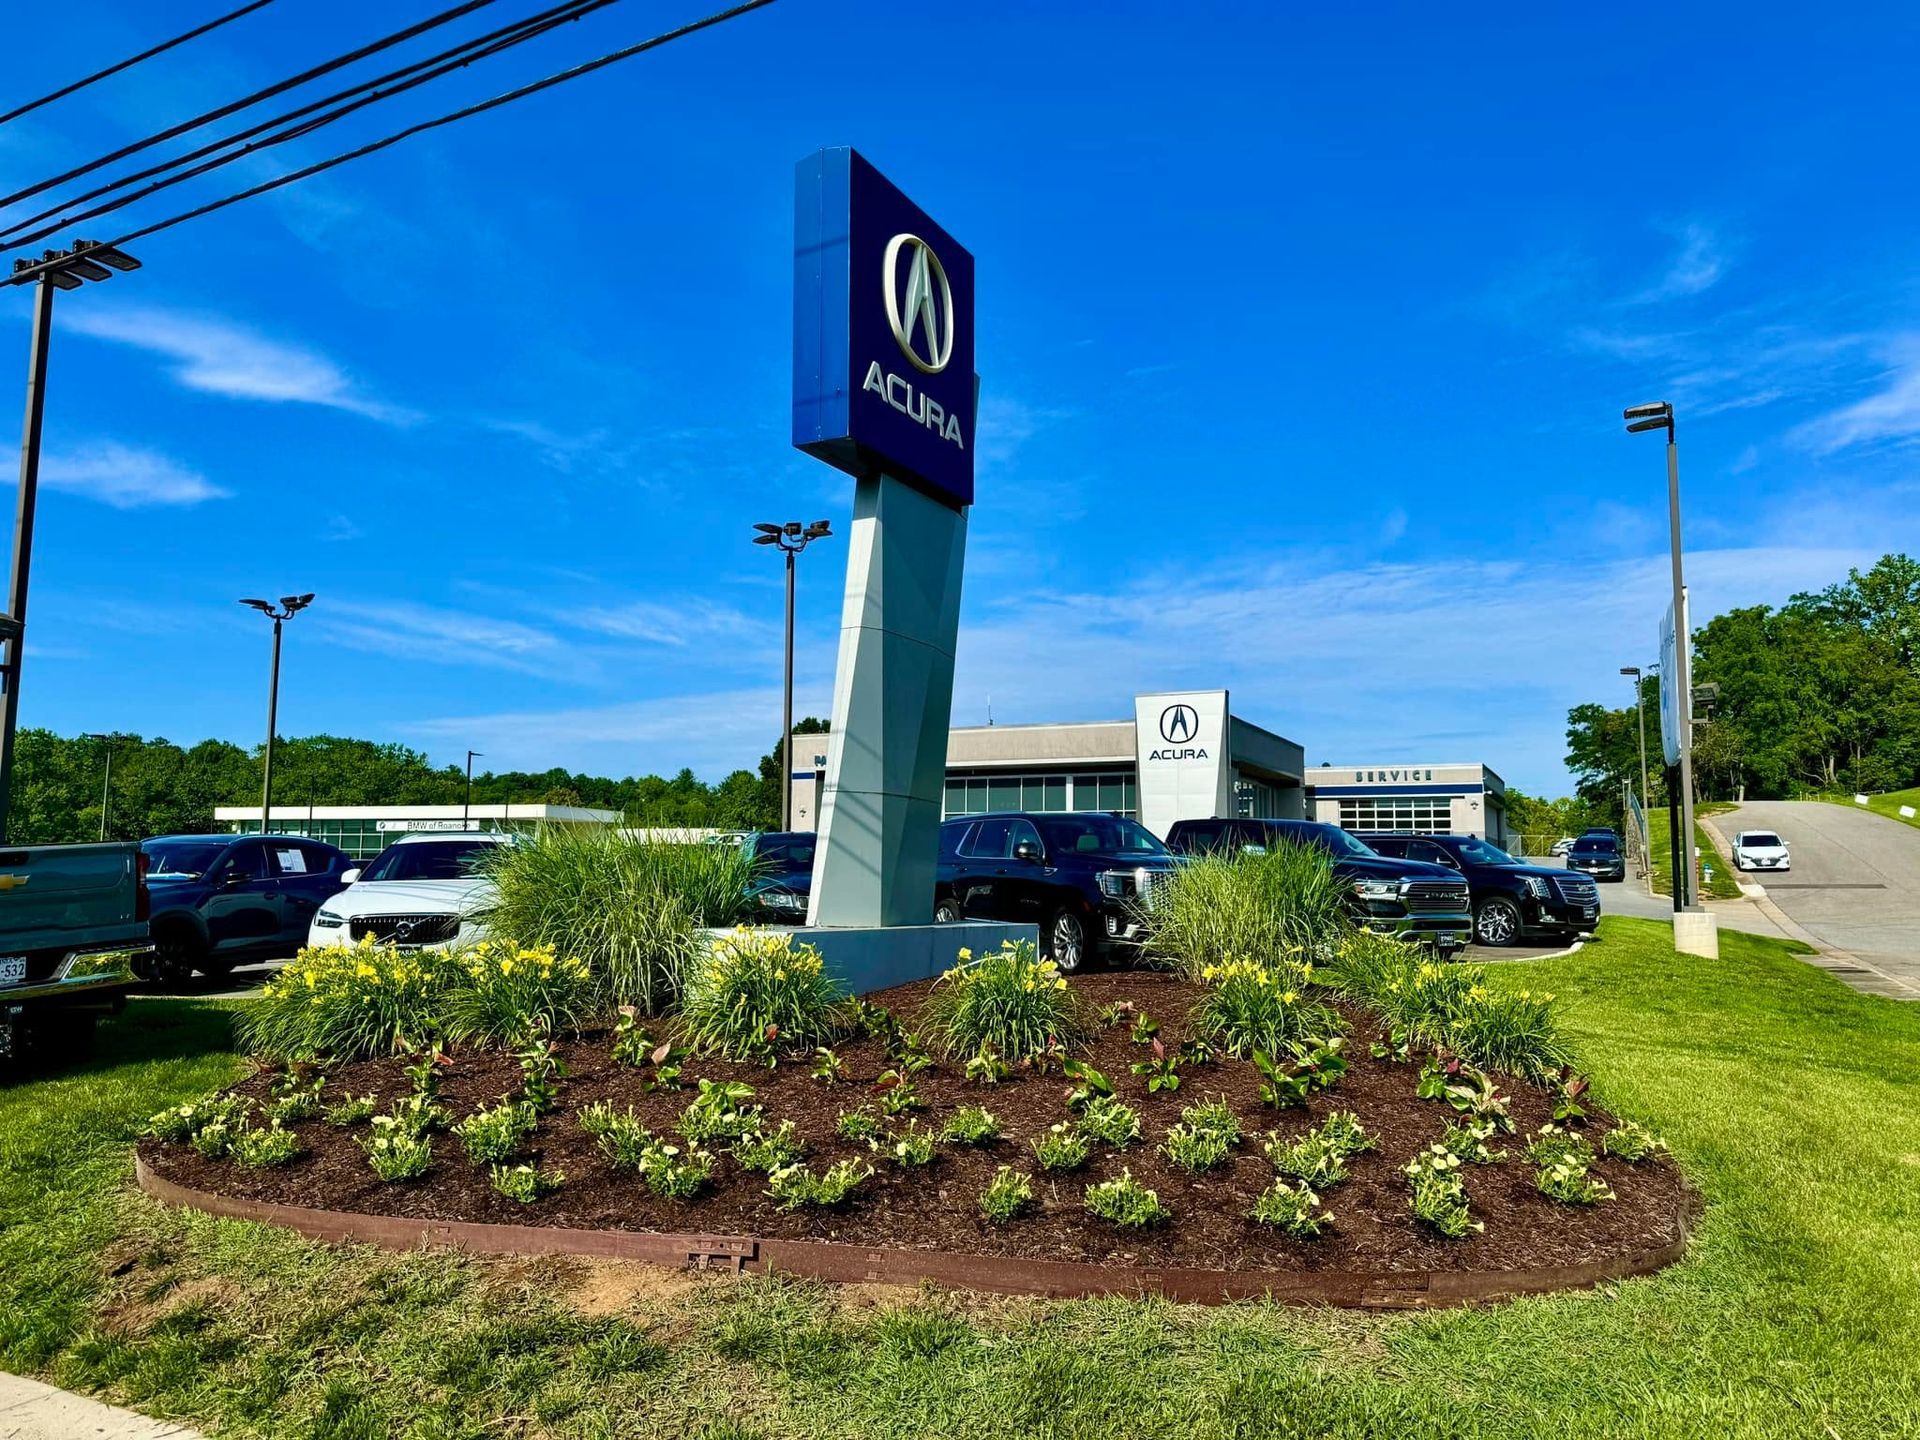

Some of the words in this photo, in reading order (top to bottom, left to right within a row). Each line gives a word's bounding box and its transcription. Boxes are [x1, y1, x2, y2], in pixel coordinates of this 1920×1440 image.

[863, 361, 964, 450] ACURA
[1149, 748, 1208, 761] ACURA
[1356, 770, 1432, 782] SERVICE
[408, 821, 428, 830] BMW
[429, 821, 437, 830] of
